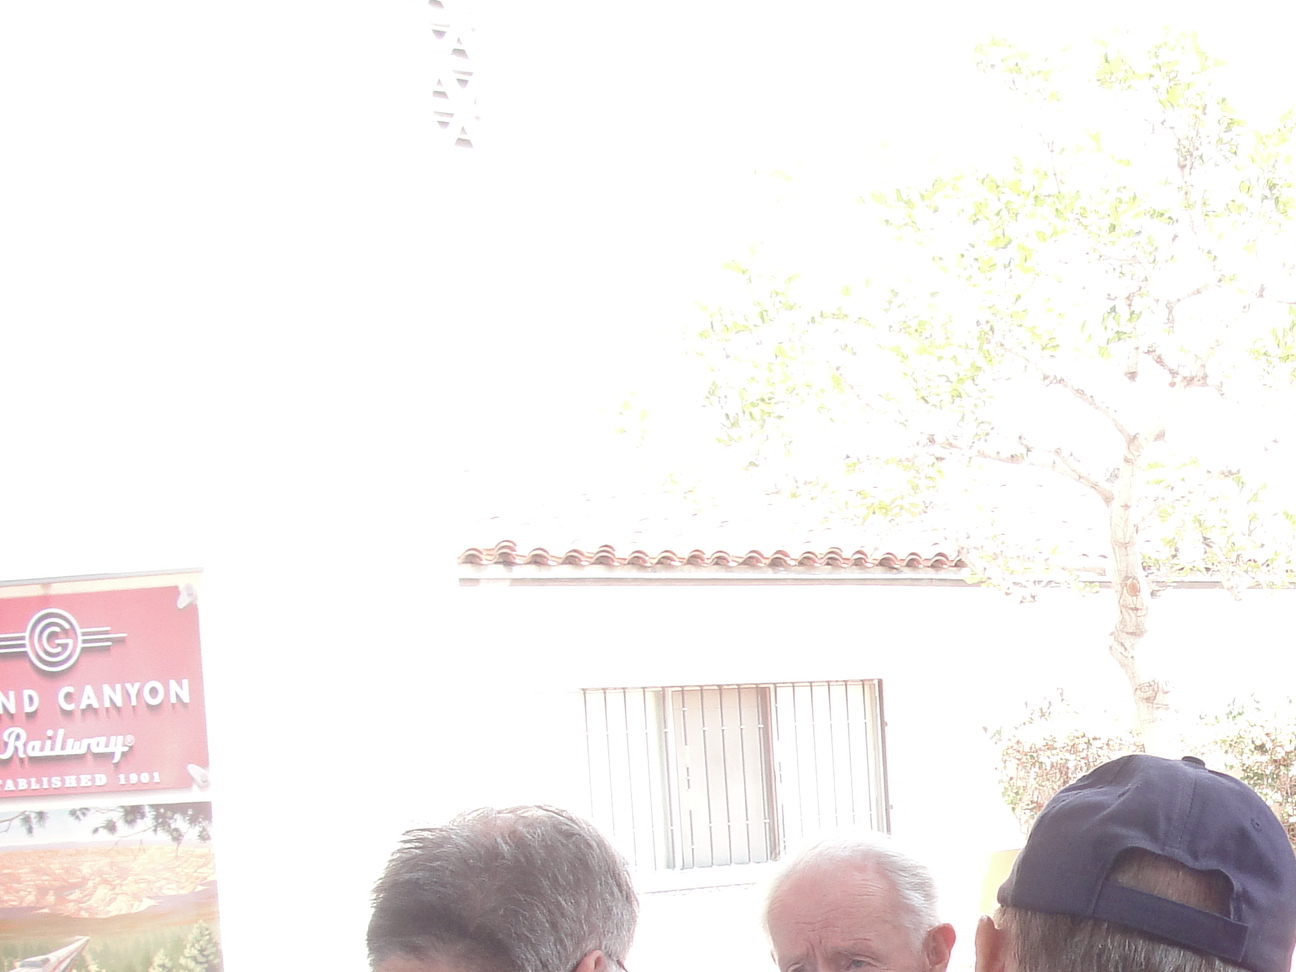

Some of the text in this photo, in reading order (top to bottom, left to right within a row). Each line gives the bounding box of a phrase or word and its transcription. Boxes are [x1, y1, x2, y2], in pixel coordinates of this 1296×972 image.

[57, 678, 190, 711] CANYON
[0, 727, 130, 764] Railway
[0, 771, 161, 791] ABLISHED 1901
